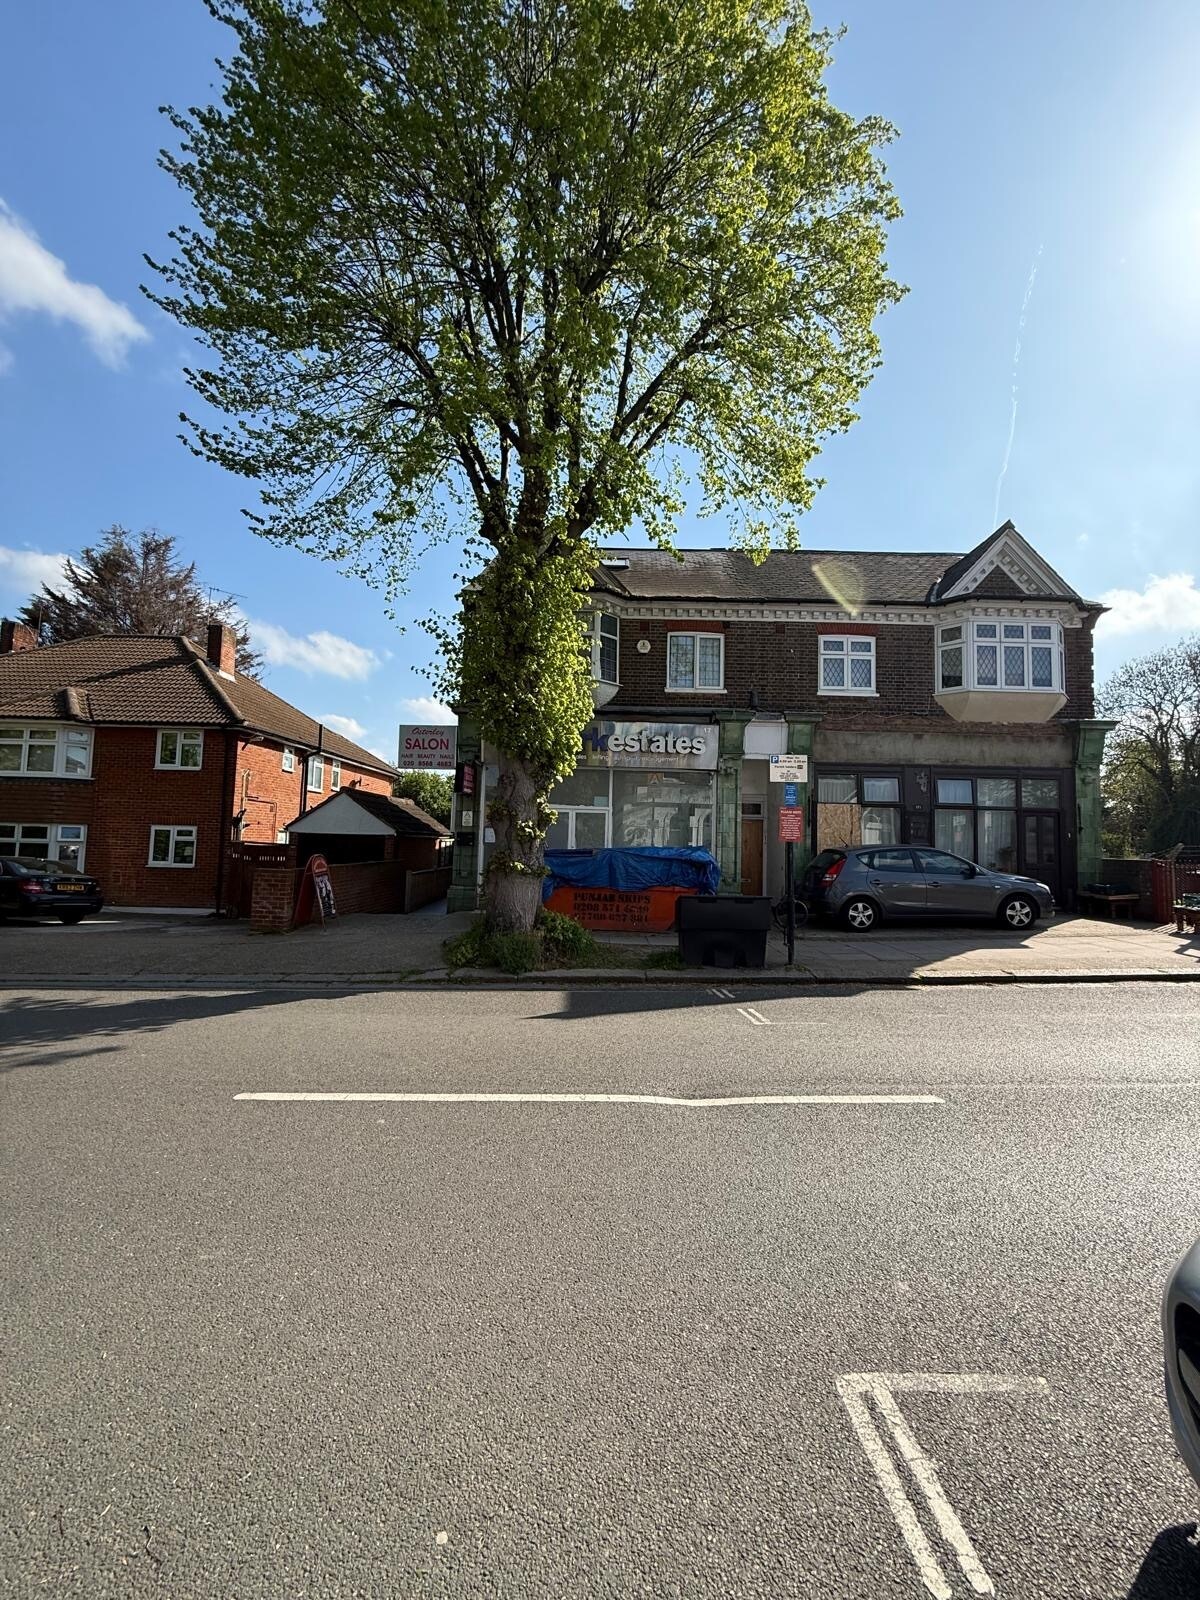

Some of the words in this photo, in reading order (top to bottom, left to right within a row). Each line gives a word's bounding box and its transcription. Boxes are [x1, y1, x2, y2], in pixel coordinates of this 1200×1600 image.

[405, 738, 449, 750] SALON
[574, 892, 616, 902] PUNJAB
[618, 893, 651, 904] SKIPS
[574, 903, 599, 912] 0208
